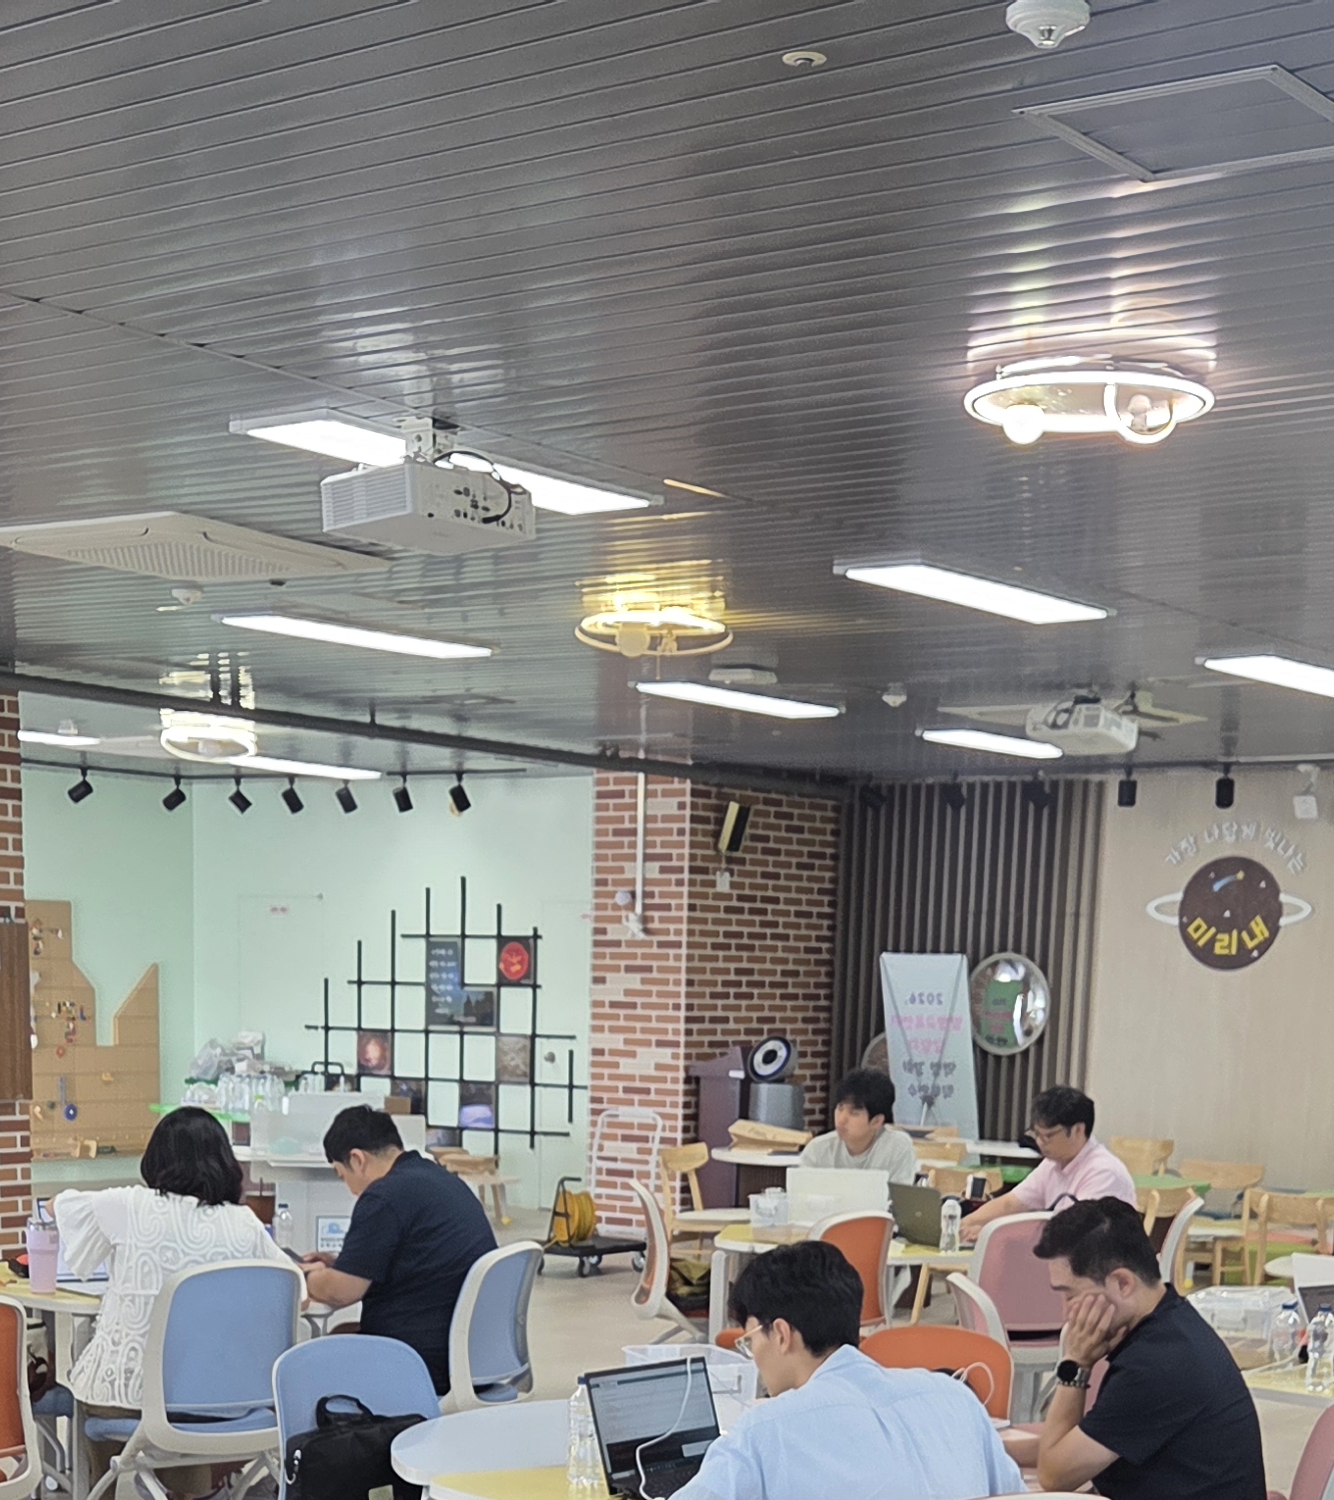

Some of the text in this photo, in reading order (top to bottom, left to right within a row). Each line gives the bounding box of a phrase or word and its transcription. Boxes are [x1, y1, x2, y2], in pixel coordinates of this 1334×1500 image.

[1165, 821, 1304, 874] 가장 나답게 빛나는
[1187, 914, 1269, 955] 미리내
